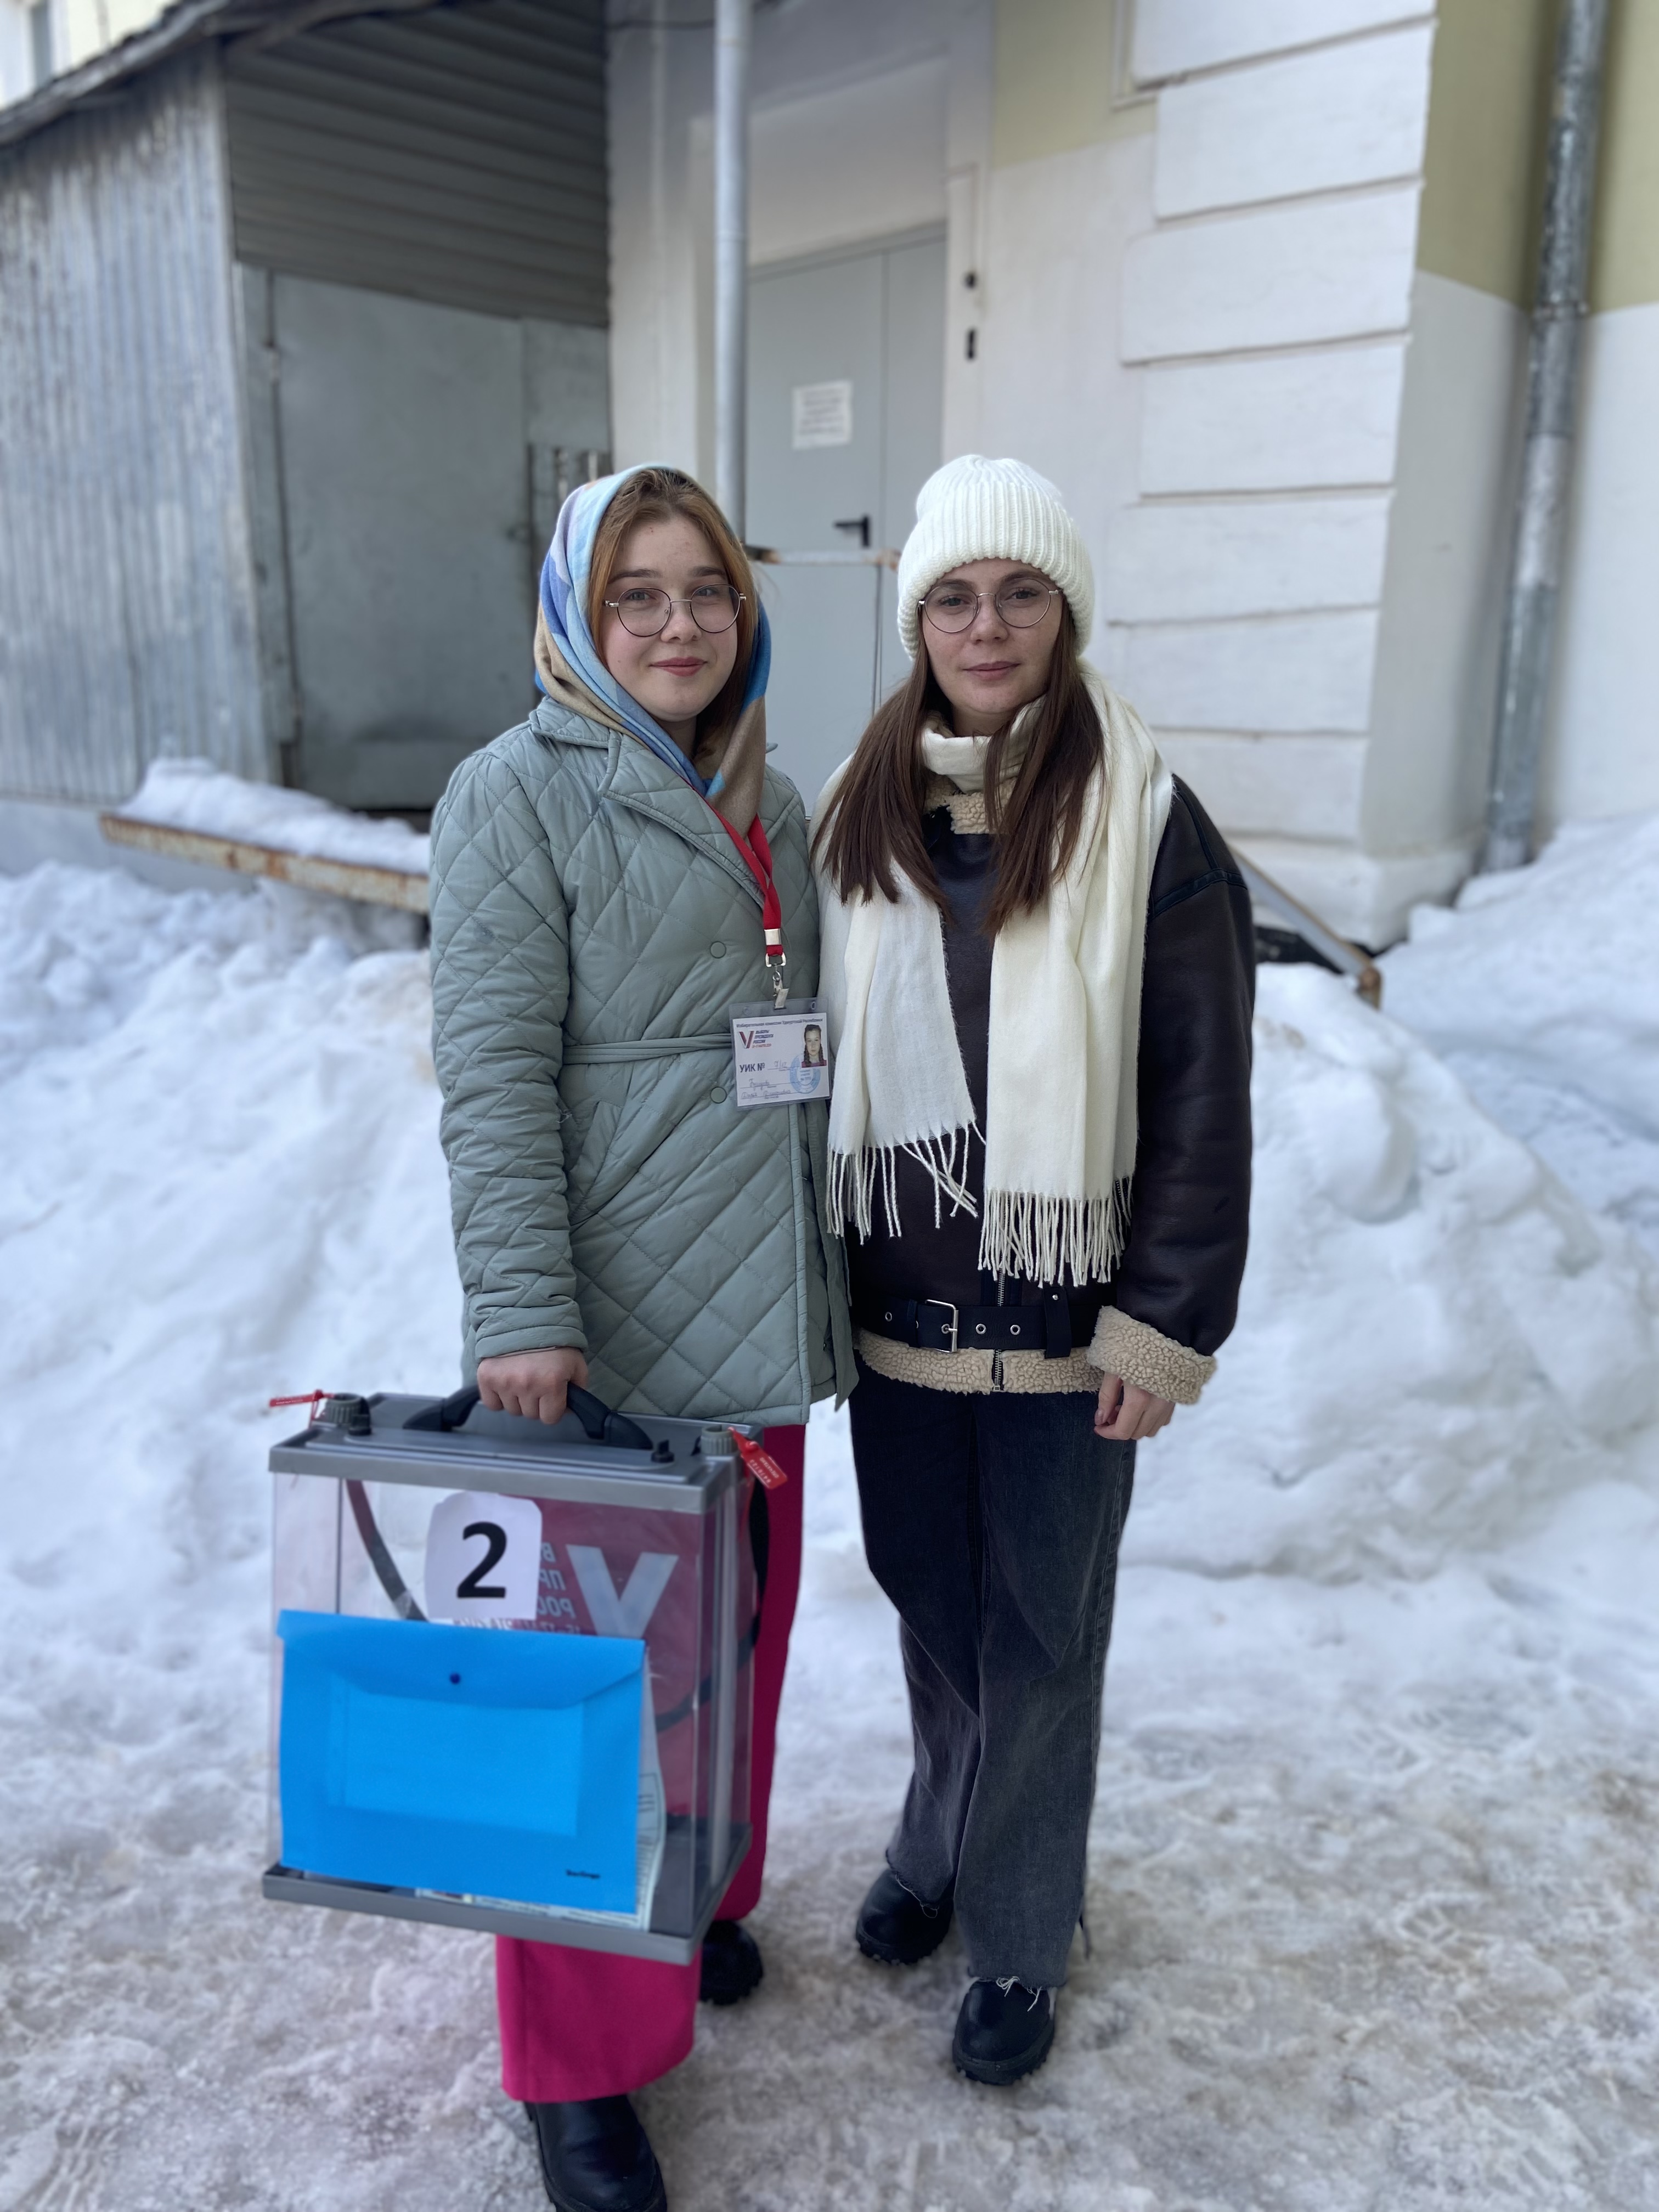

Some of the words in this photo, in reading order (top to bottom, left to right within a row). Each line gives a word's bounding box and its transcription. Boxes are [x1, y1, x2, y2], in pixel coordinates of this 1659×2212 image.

[740, 1063, 755, 1073] УИК
[757, 1062, 765, 1071] №
[456, 1521, 507, 1599] 2
